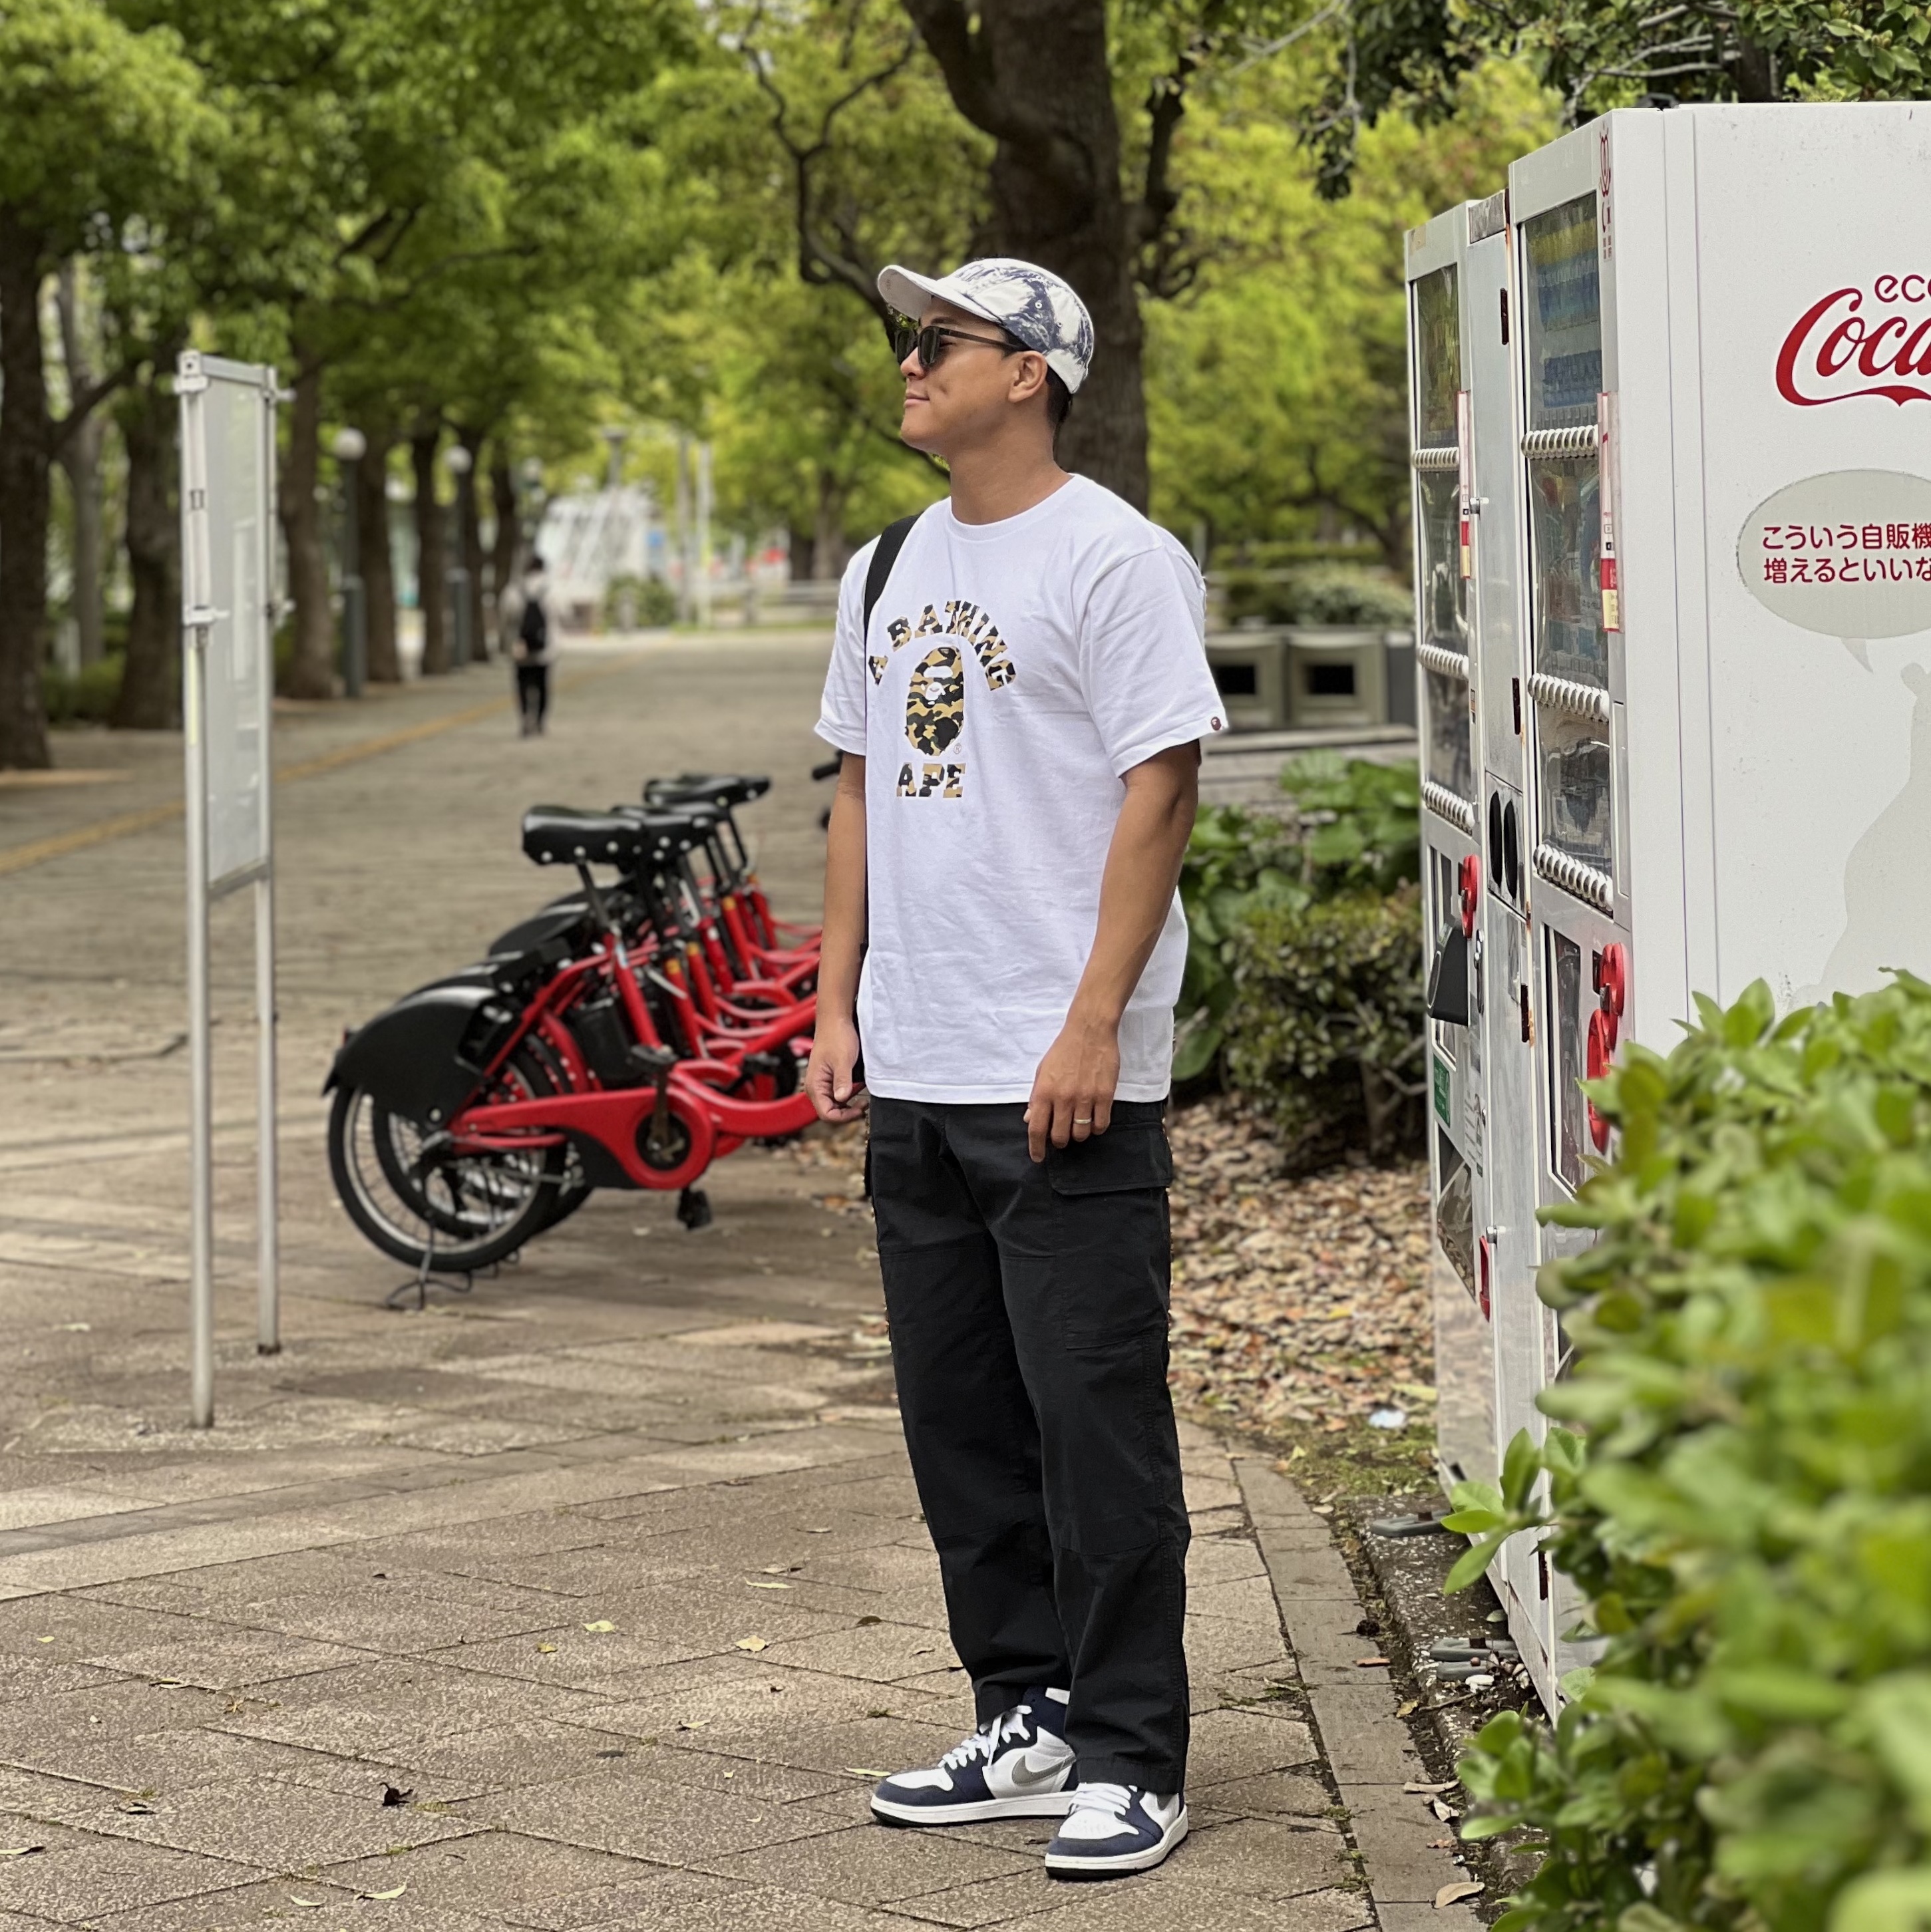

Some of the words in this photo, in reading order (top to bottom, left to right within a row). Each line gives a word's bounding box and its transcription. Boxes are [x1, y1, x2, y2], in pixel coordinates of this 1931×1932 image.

[1874, 274, 1931, 303] ec
[1763, 523, 1931, 550] こういう自販機
[1763, 557, 1931, 583] 増えるといいな
[886, 600, 1017, 691] BATHING
[896, 762, 966, 798] APE
